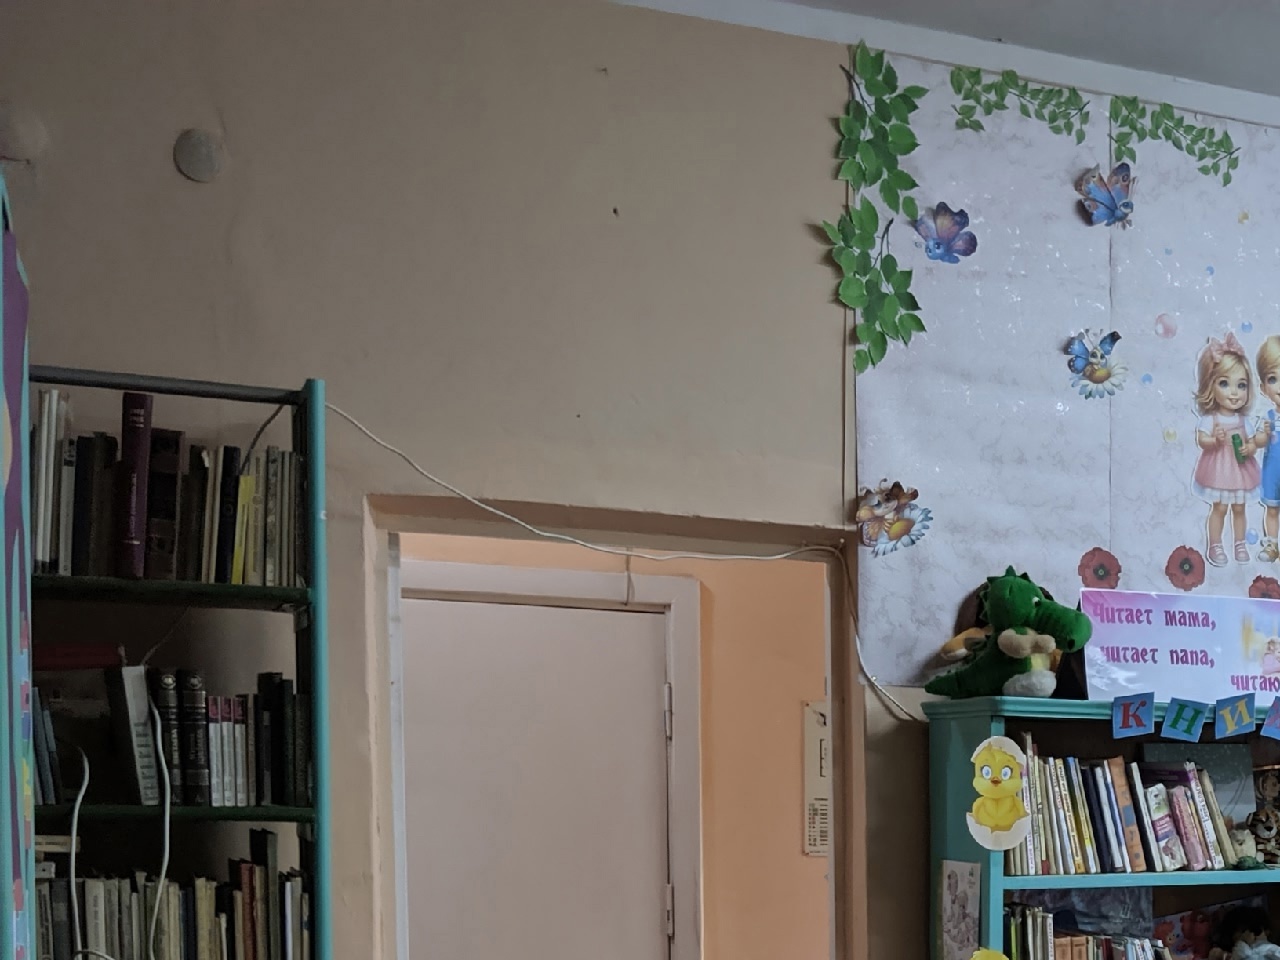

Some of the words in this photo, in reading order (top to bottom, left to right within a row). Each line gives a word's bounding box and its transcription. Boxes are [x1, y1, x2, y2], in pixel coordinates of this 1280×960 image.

[1093, 602, 1154, 625] Читает
[1164, 606, 1216, 630] мама,
[1101, 645, 1159, 664] читает
[1170, 647, 1215, 669] папа,
[1230, 673, 1280, 692] читаю
